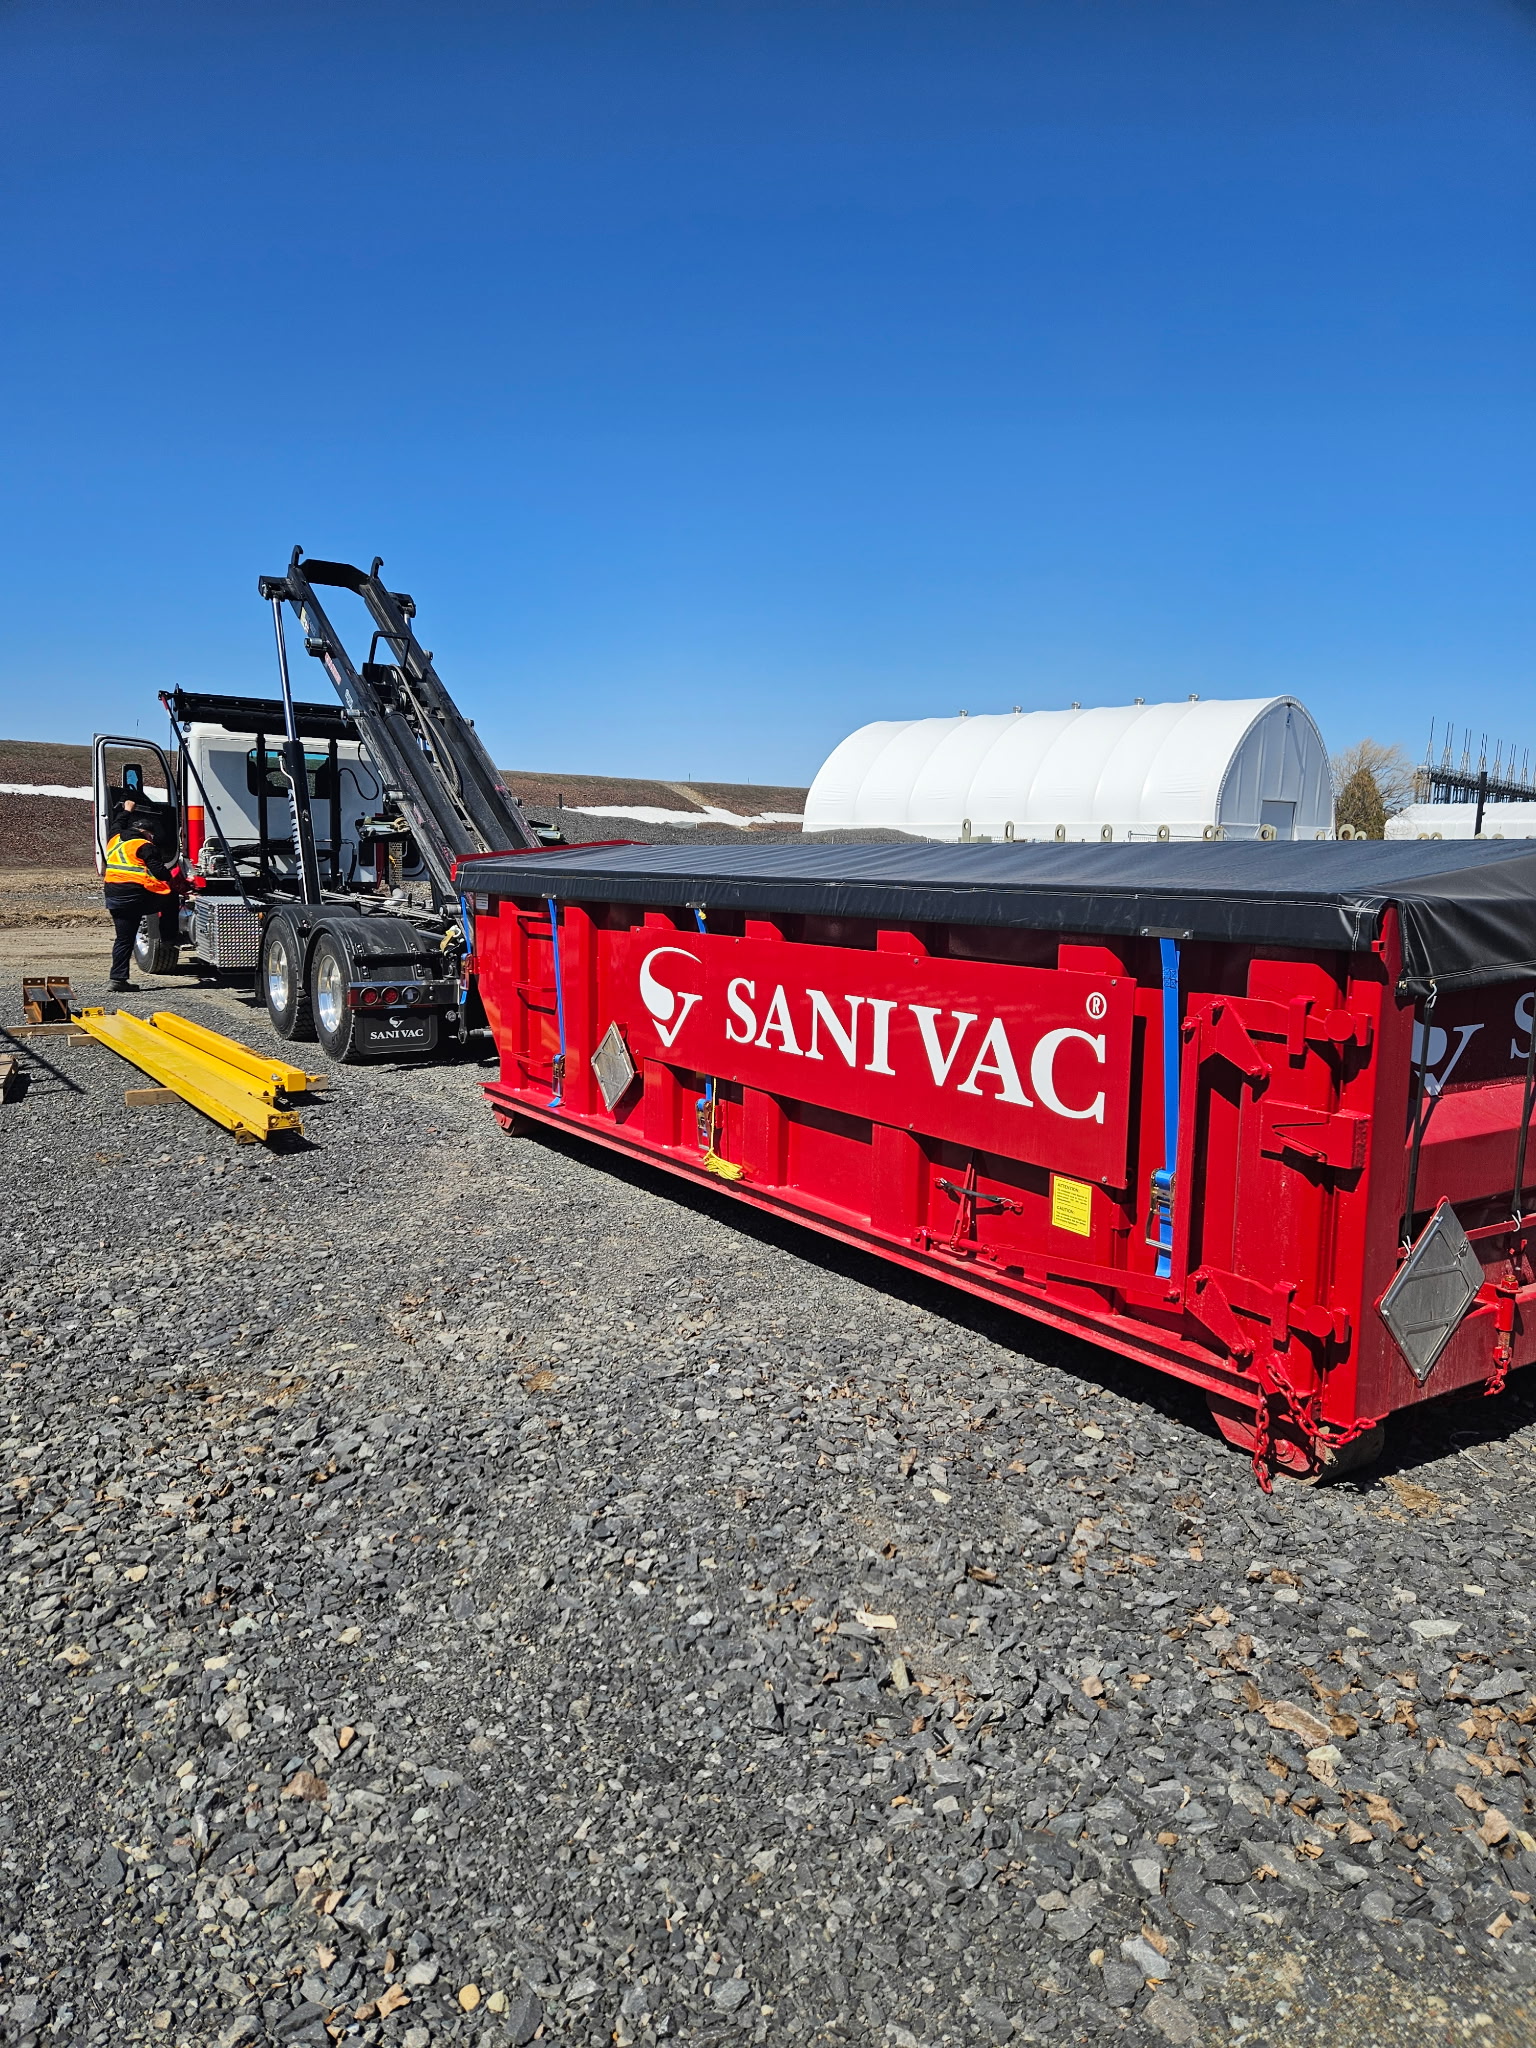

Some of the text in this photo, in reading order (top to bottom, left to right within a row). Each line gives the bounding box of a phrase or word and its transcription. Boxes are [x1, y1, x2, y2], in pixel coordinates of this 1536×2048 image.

[371, 1029, 423, 1039] SANI VAC
[725, 977, 1106, 1124] SANI VAC
